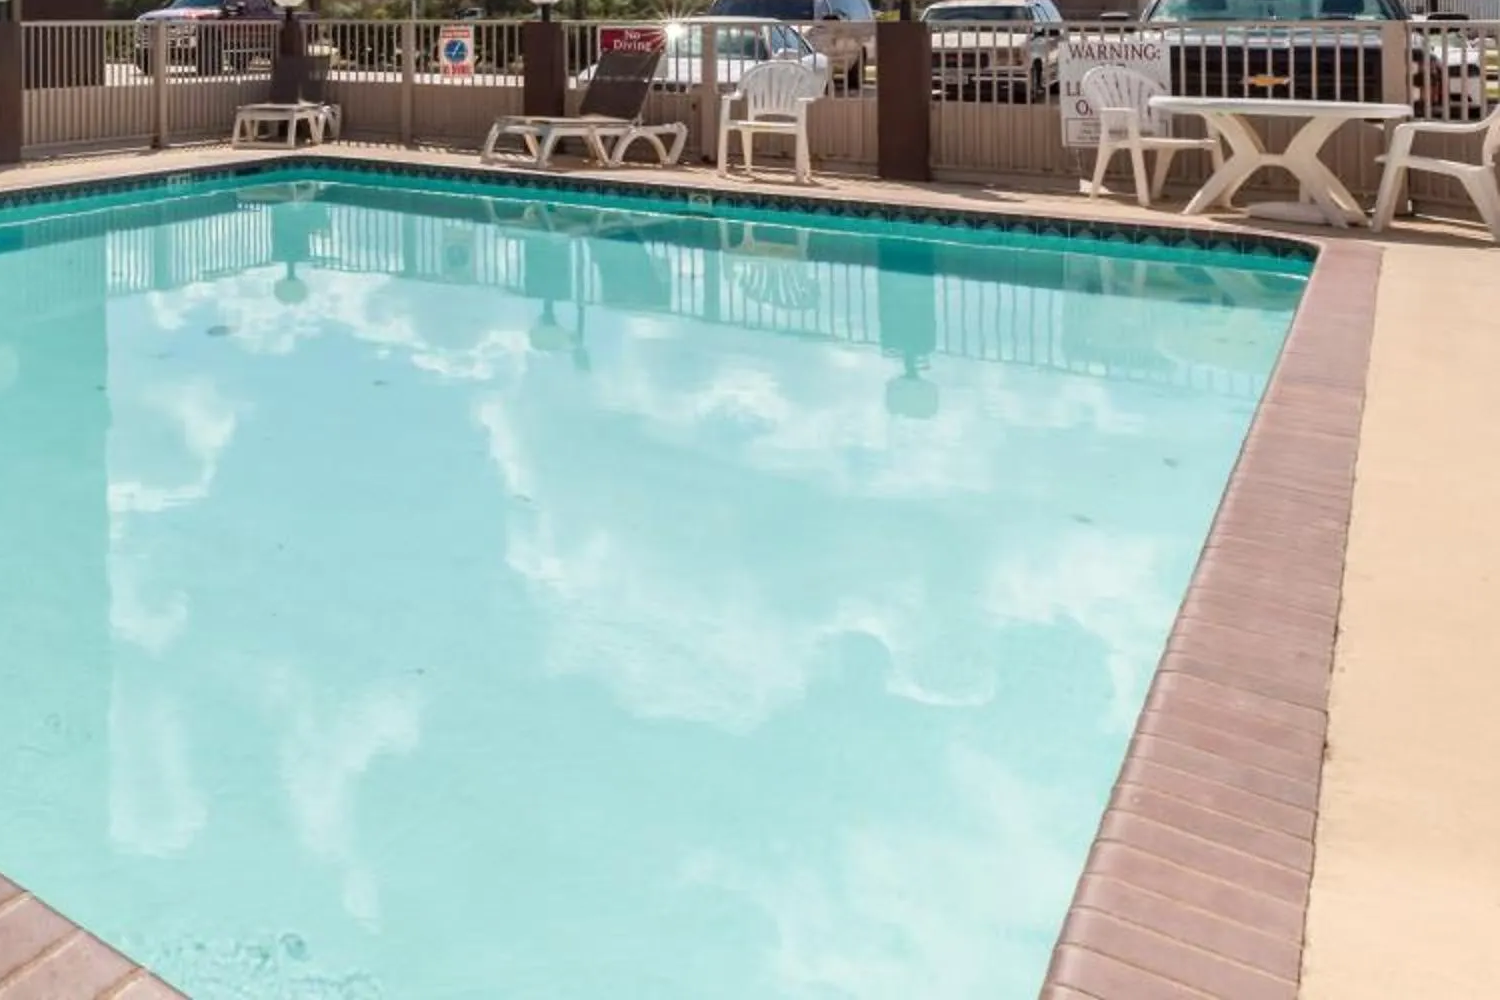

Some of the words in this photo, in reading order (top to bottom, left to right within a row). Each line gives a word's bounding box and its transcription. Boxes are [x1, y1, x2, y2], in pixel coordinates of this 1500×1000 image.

[624, 29, 641, 39] No
[613, 40, 652, 52] Diving
[1068, 43, 1161, 60] WARNING:
